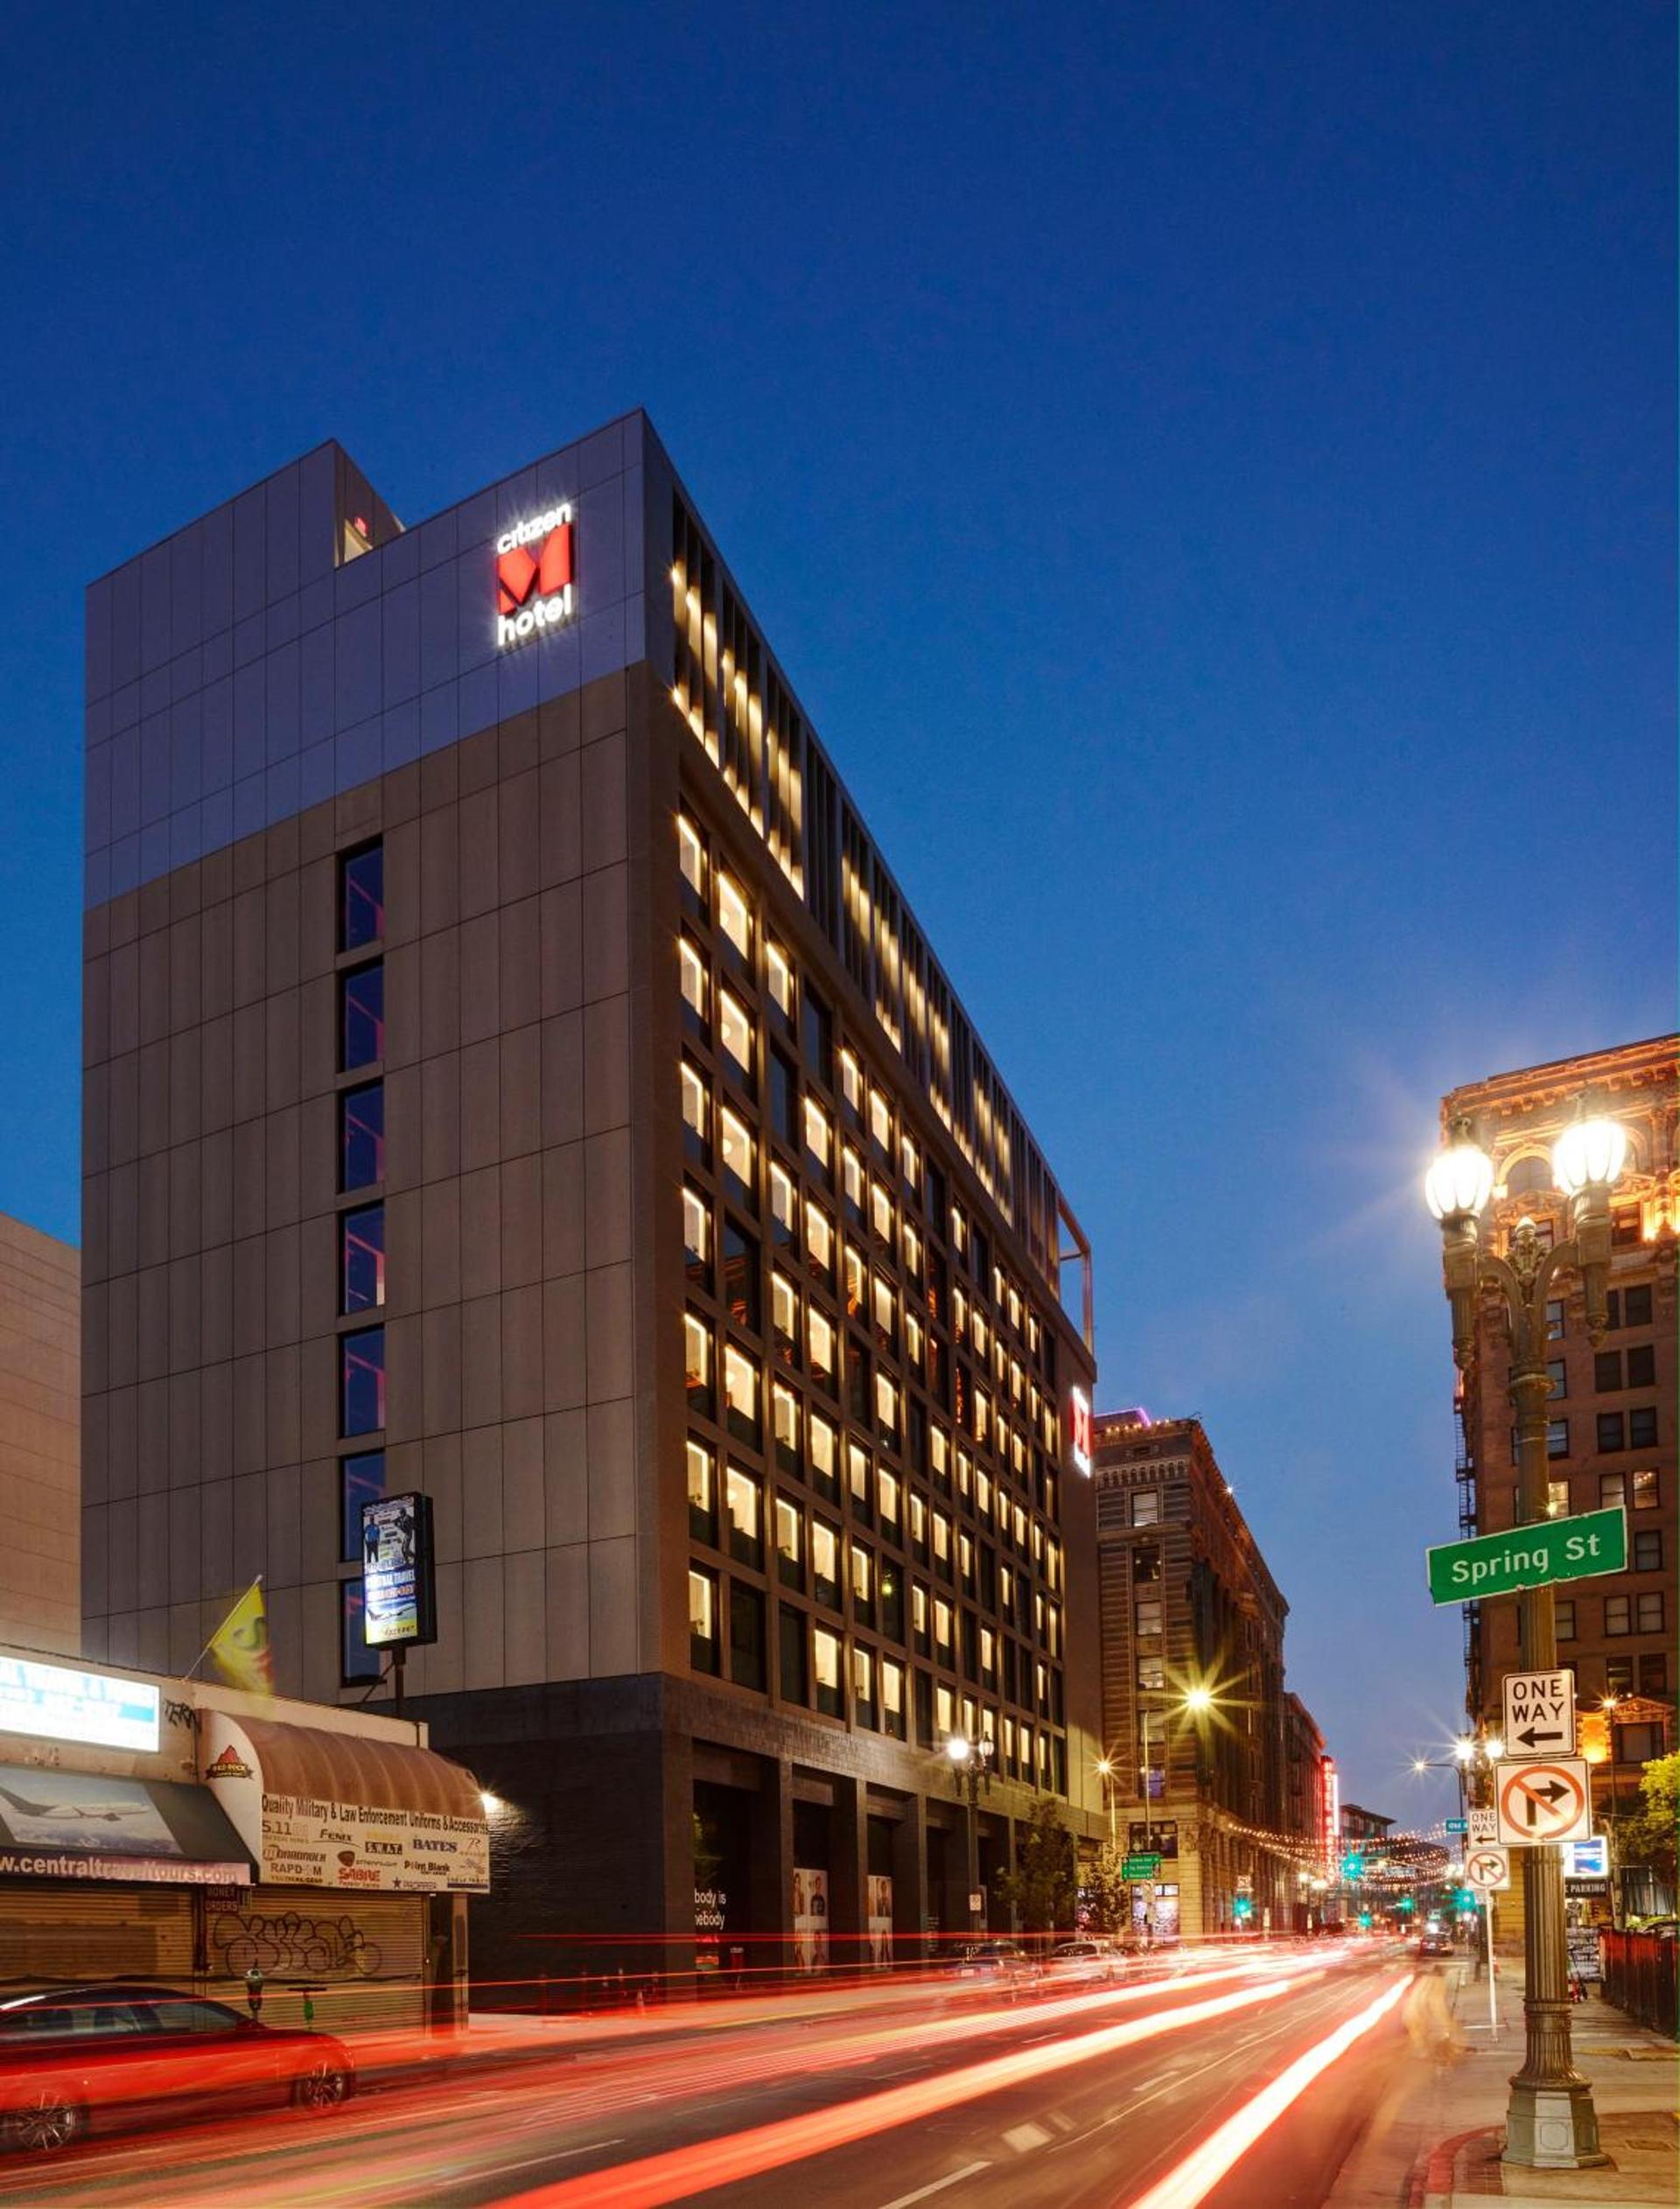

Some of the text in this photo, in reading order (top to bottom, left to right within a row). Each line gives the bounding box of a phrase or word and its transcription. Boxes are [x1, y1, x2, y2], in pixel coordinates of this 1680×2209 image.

[497, 503, 571, 554] citizen
[497, 584, 572, 646] hotel
[1452, 1533, 1600, 1585] Spring St
[1513, 1680, 1564, 1701] ONE
[1512, 1701, 1564, 1723] WAY
[1324, 1762, 1333, 1812] HOTEL
[262, 1794, 293, 1819] Quality
[297, 1799, 327, 1822] Military
[331, 1802, 337, 1820] &
[340, 1804, 356, 1822] Law
[359, 1806, 407, 1826] Enforcement
[410, 1811, 441, 1830] Uniforms
[443, 1815, 448, 1831] &
[1472, 1813, 1496, 1821] ONE
[1472, 1823, 1496, 1833] WAY
[413, 1839, 458, 1854] BATES
[270, 1862, 322, 1876] RAPDM
[338, 1868, 380, 1883] SABRE
[718, 1890, 727, 1904] is
[1570, 1883, 1606, 1894] PARKING
